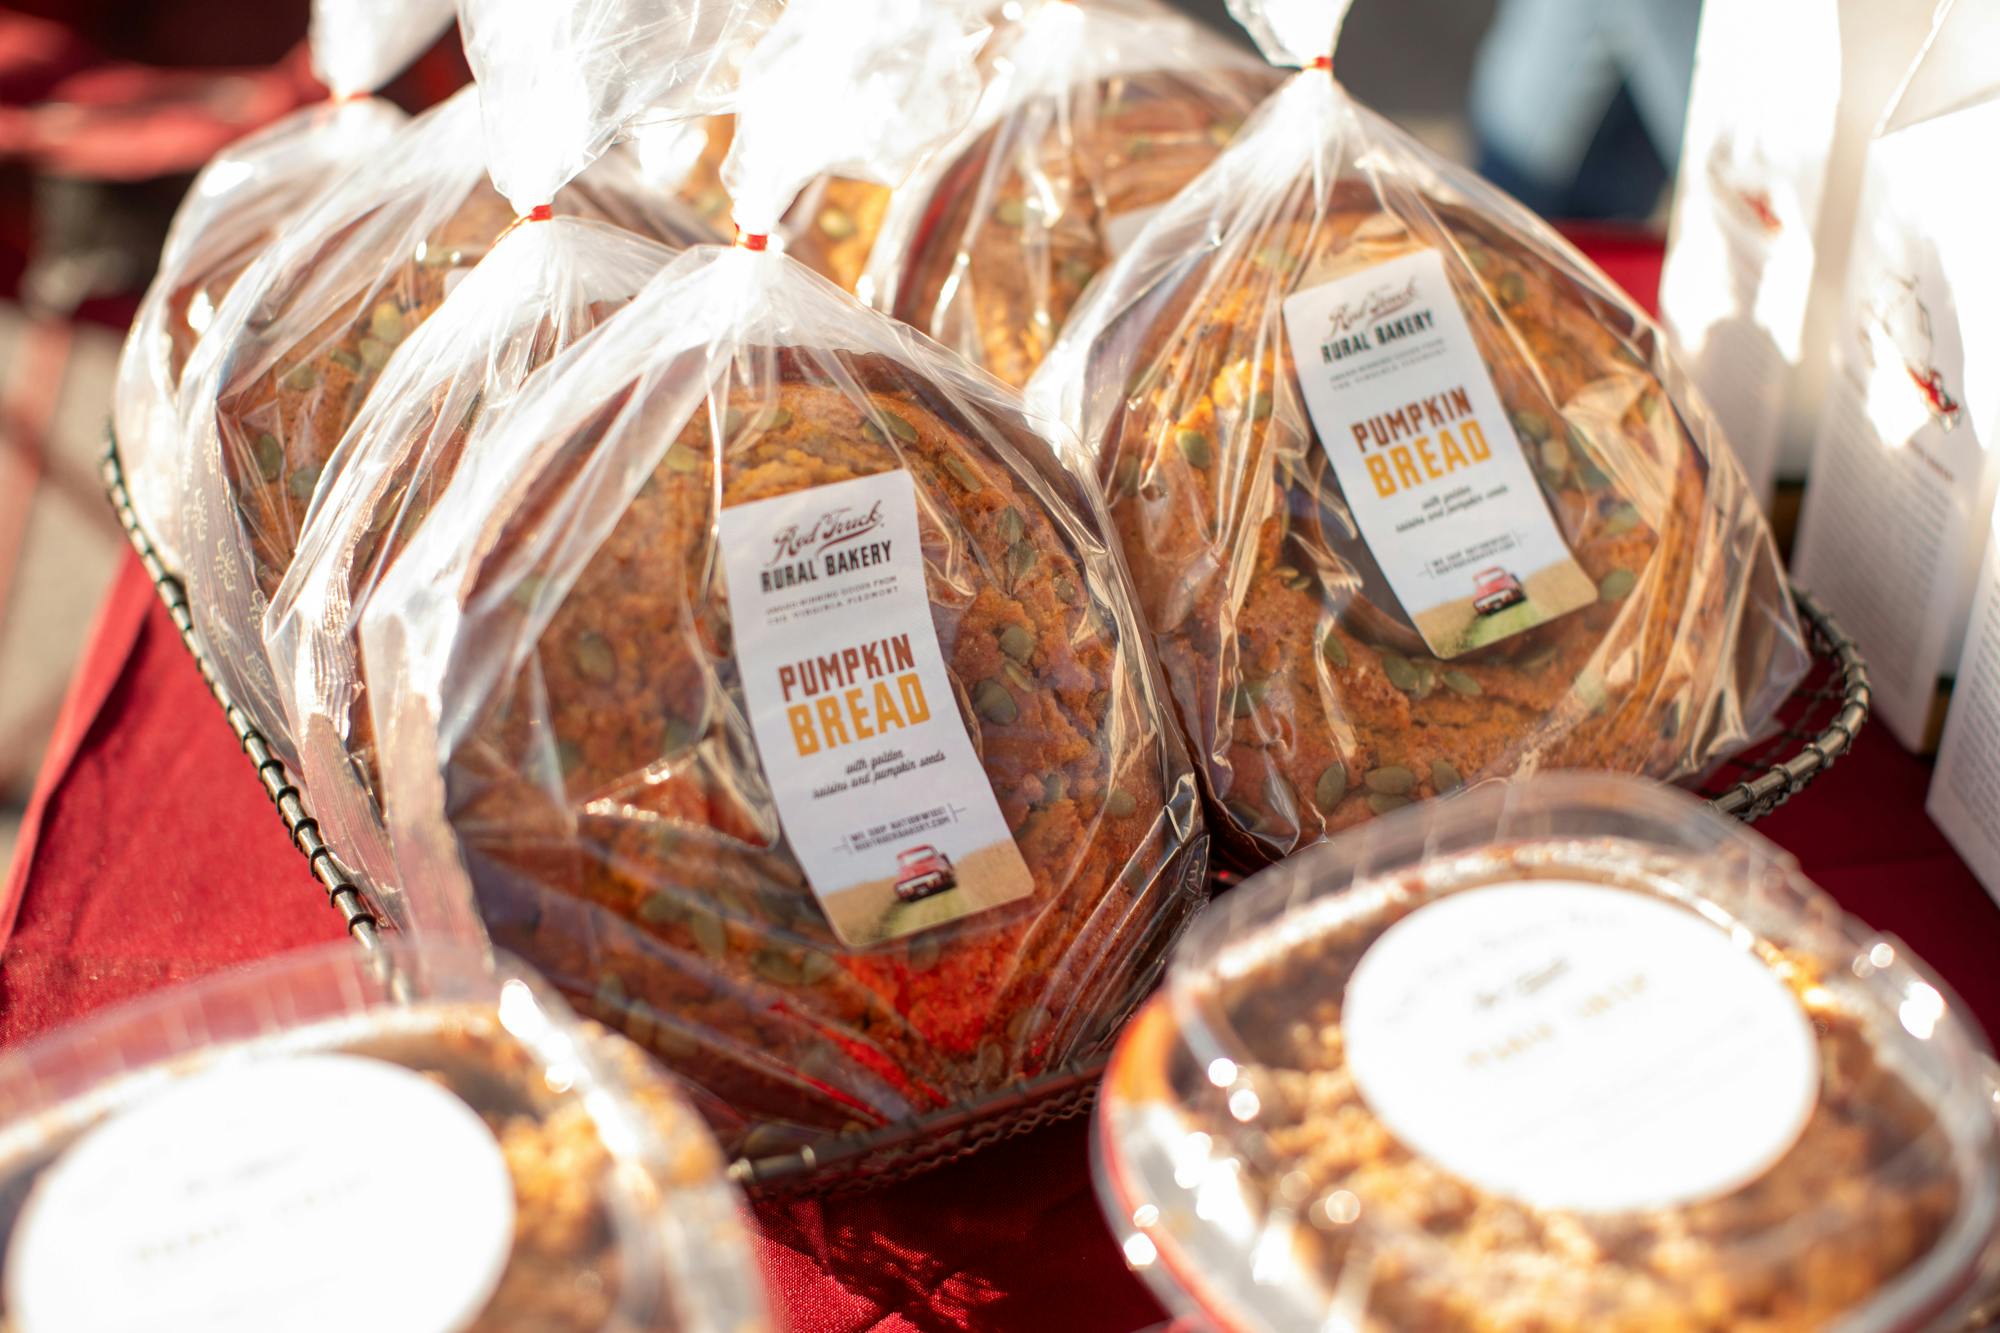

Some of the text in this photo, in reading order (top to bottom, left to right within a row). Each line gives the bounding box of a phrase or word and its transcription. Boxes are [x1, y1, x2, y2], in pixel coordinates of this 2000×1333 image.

[1320, 332, 1371, 365] RURAL
[1375, 309, 1434, 345] BAKERY
[1351, 385, 1473, 453] PUMPKIN
[1364, 419, 1492, 499] BREAD
[765, 499, 883, 566] Red Truck
[760, 540, 893, 594] RURAL BAKERY
[778, 633, 915, 703] PUMPKIN
[787, 672, 931, 759] BREAD
[812, 748, 947, 800] raisins and pumpkin seeds
[846, 749, 905, 776] with golden
